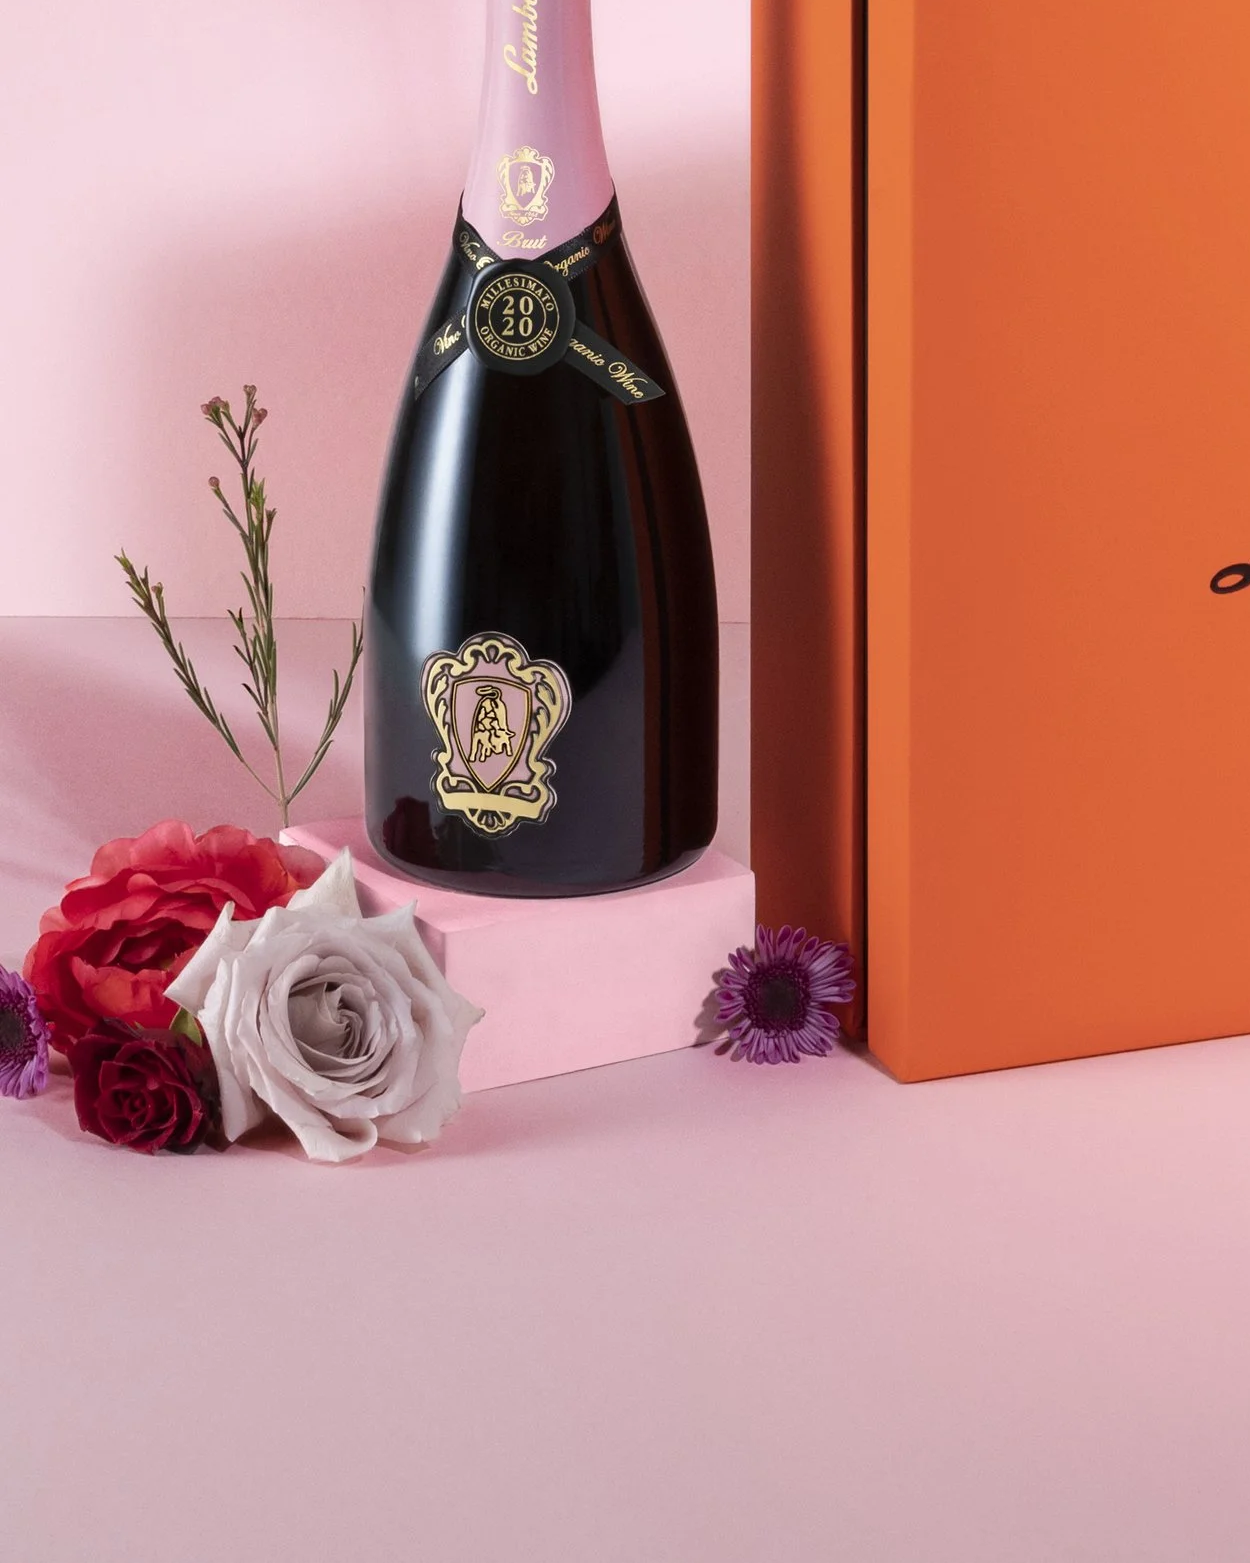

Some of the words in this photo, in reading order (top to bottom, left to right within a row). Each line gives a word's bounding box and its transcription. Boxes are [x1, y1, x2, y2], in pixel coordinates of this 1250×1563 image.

[496, 230, 548, 249] Brut
[480, 277, 555, 312] MILLESIMATO
[480, 326, 527, 357] ORGANIC
[527, 327, 554, 353] WINE
